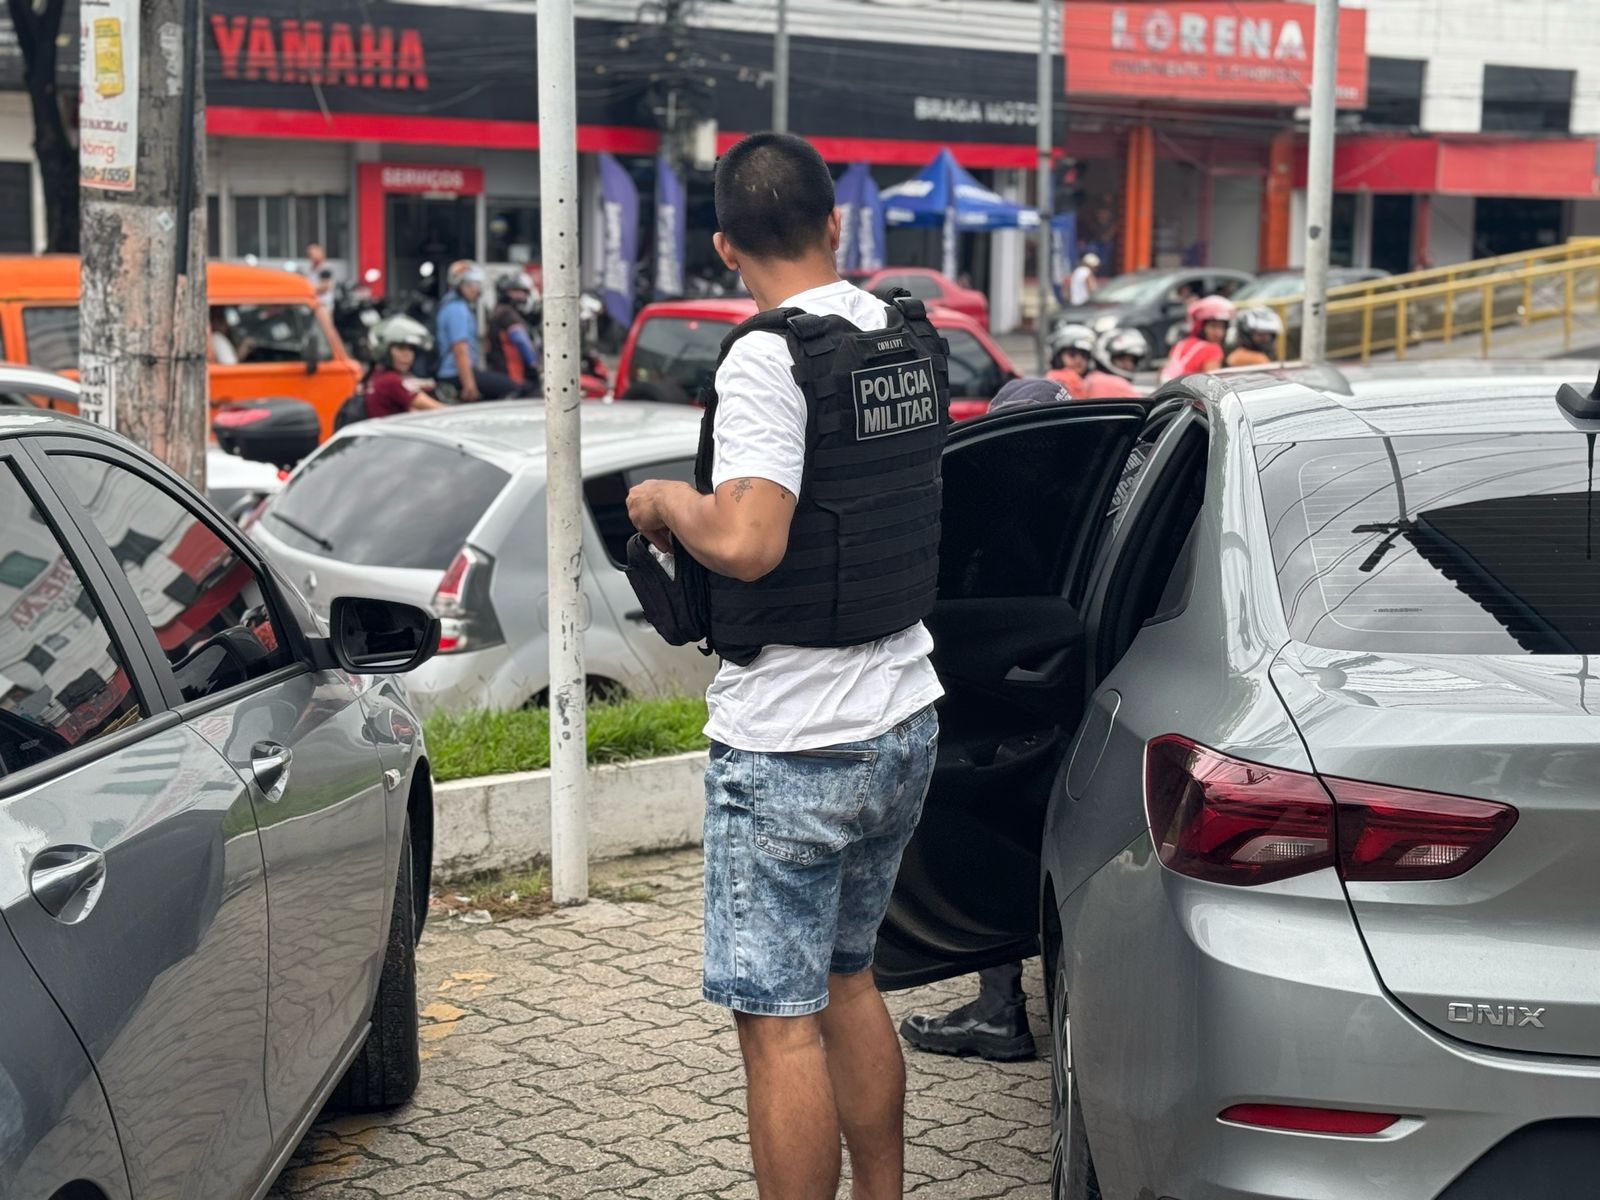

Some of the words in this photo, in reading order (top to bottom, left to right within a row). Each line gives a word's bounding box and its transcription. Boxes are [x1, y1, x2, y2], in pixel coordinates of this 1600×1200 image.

[210, 14, 429, 89] YAMAHA
[1110, 9, 1308, 60] LORENA
[914, 96, 983, 122] BRAGA
[382, 167, 464, 190] SERVIÇOS
[860, 368, 931, 404] POLÍCIA
[864, 397, 933, 433] MILITAR
[1448, 1002, 1545, 1028] ONIX
